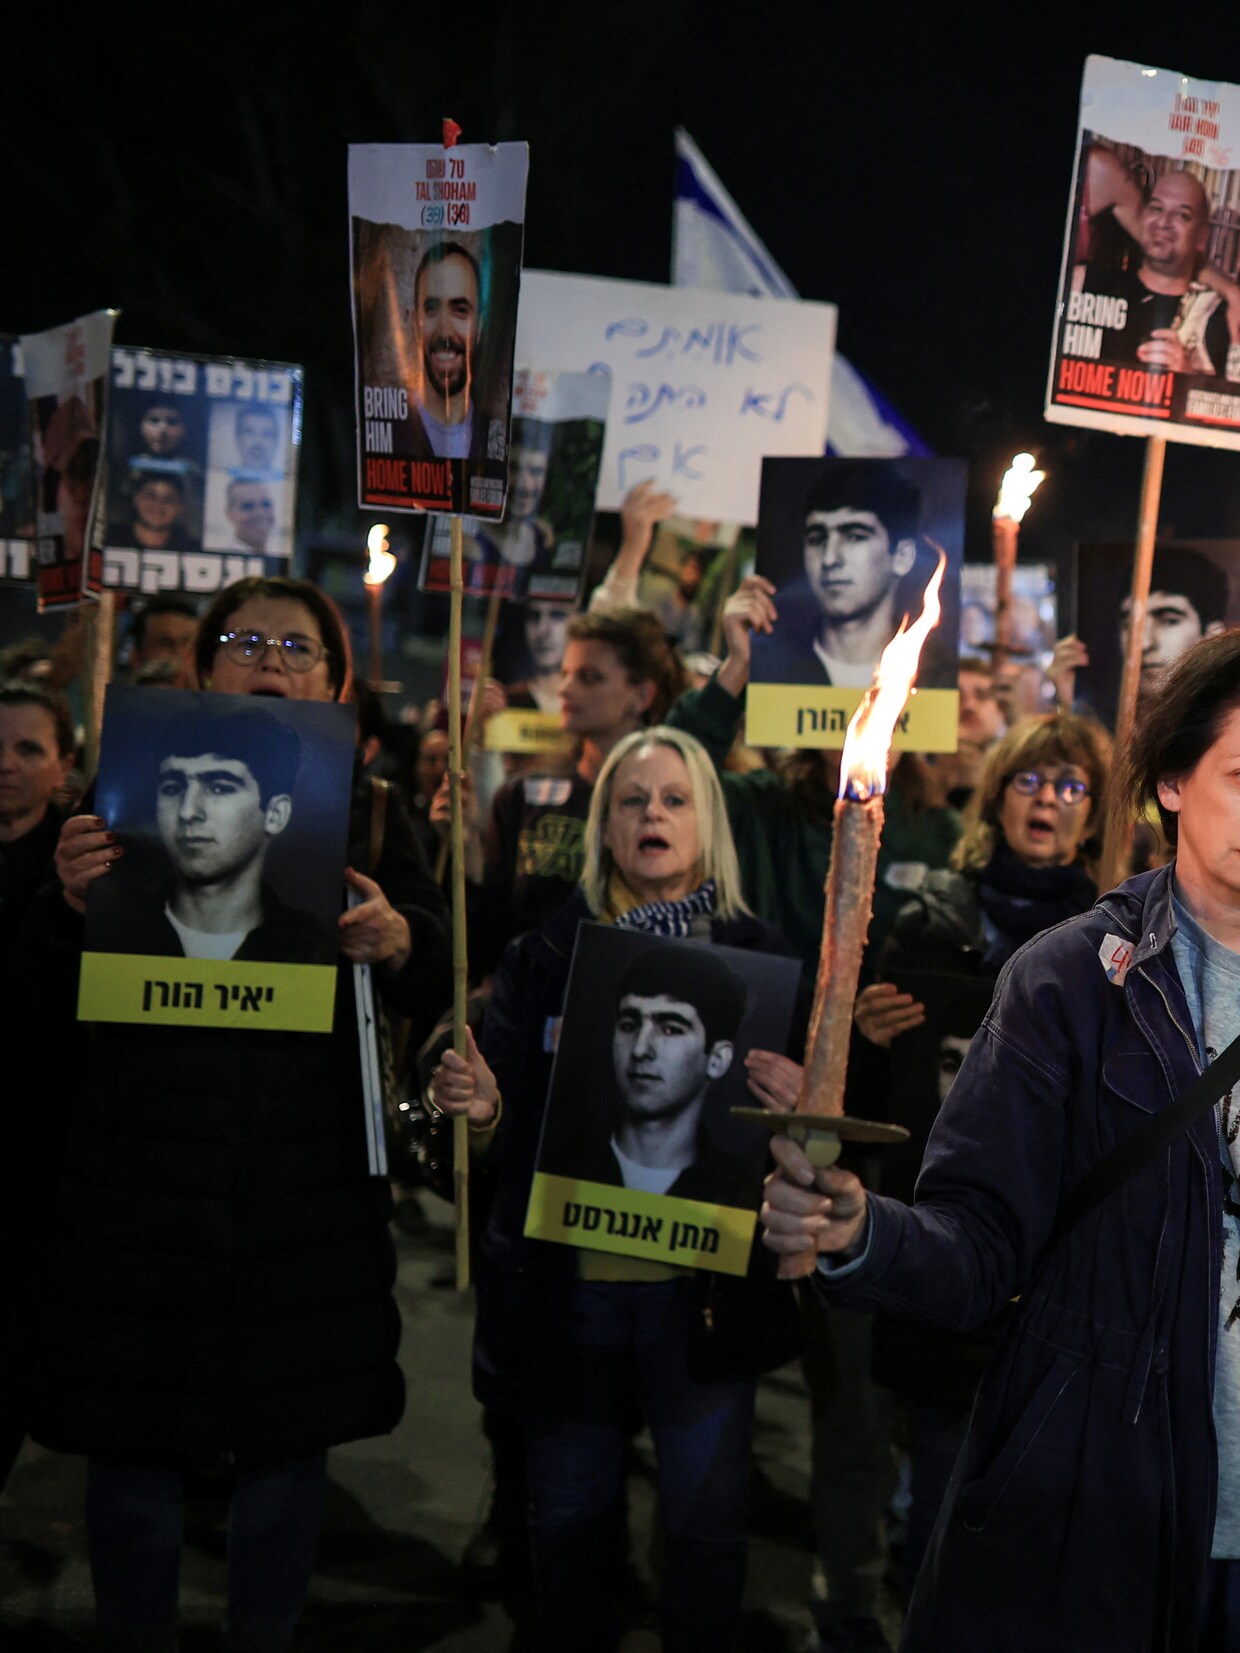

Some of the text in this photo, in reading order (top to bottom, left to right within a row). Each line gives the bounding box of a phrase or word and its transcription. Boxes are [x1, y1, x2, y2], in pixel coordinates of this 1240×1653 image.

[449, 158, 464, 178] טל
[415, 182, 476, 201] TAL SHOHAM
[1067, 291, 1128, 330] BRING
[1063, 323, 1103, 359] HIM
[1059, 359, 1116, 397] HOME
[1117, 364, 1174, 407] NOW!
[364, 384, 408, 420] BRING
[739, 382, 816, 424] לא
[365, 421, 393, 453] HIM
[366, 459, 408, 492] HOME
[411, 460, 453, 497] NOW!
[797, 708, 846, 735] הורן
[142, 980, 275, 1012] יאיר הורן
[563, 1201, 720, 1254] מתן אנגרסט
